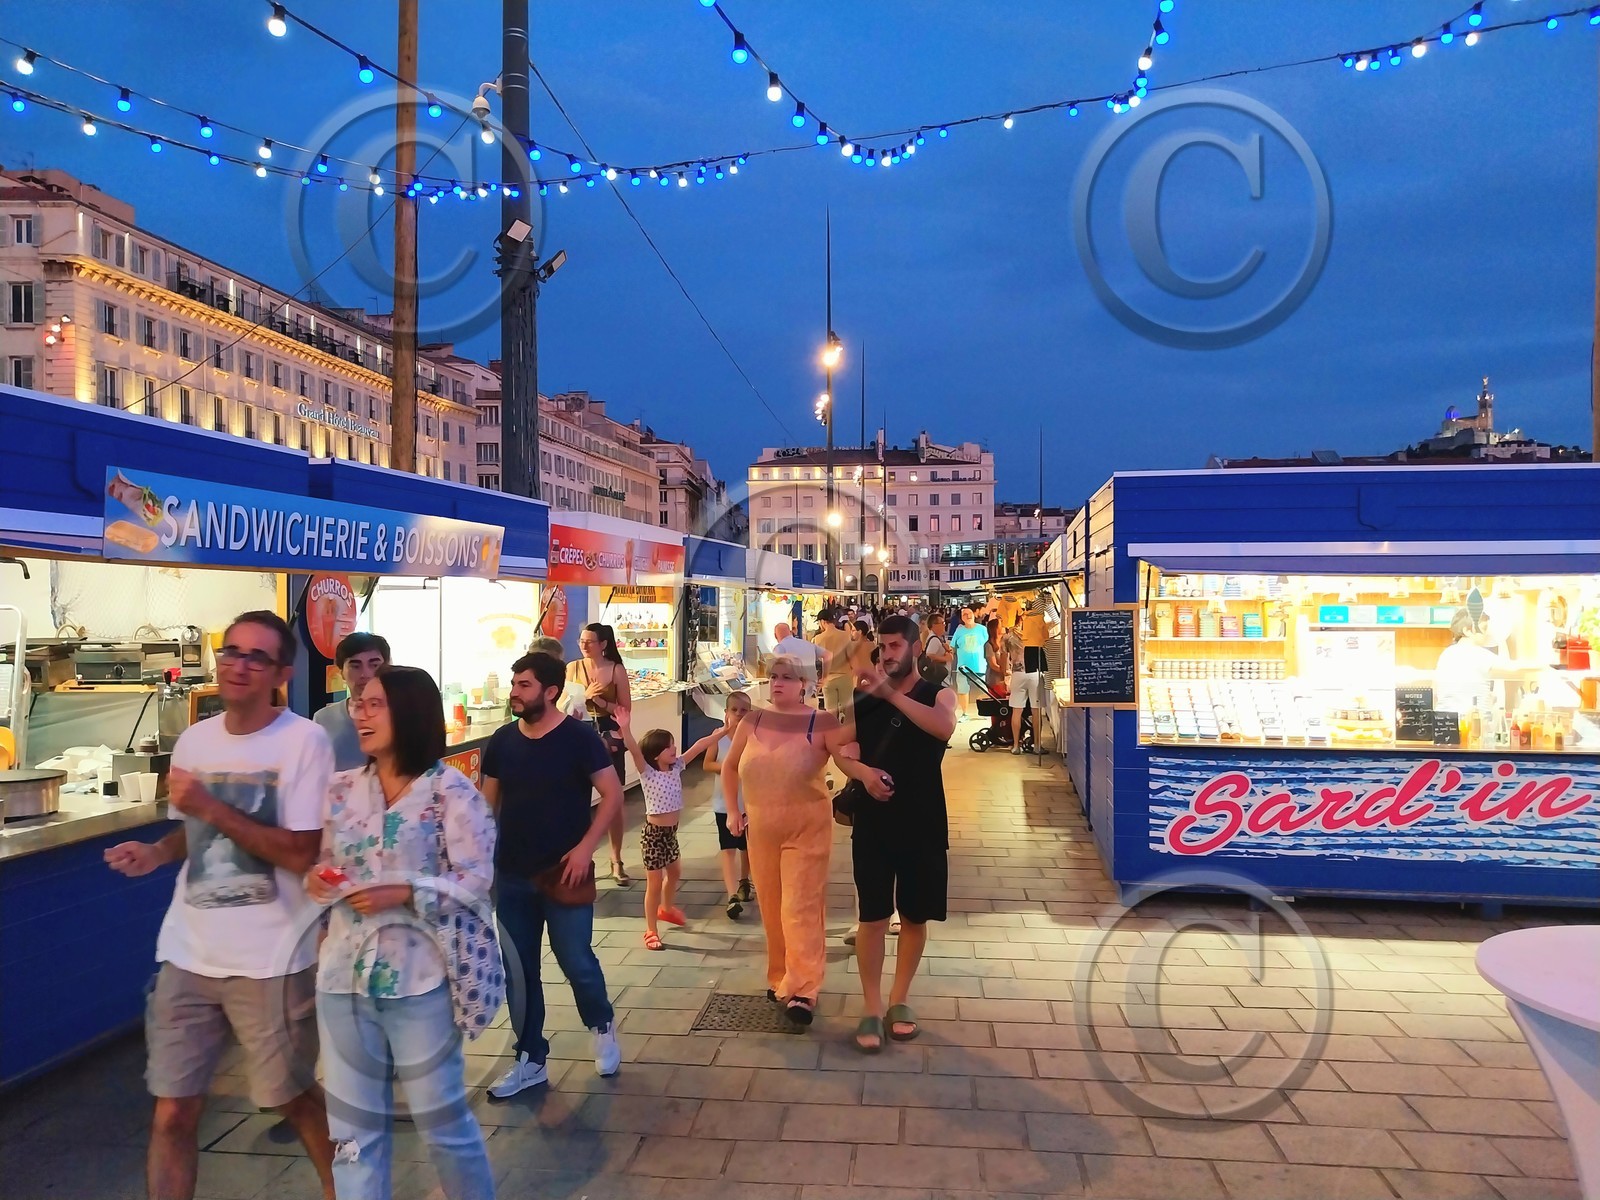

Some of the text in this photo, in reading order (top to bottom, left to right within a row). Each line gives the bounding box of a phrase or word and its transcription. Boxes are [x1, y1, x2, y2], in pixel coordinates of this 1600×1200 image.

[297, 402, 324, 421] Grand
[160, 495, 480, 568] SANDWICHERIE & BOISSONS
[559, 542, 584, 566] CRÊPES
[598, 551, 625, 570] CHURROS
[310, 578, 354, 608] CHURROS
[1167, 759, 1593, 856] Sard'in
